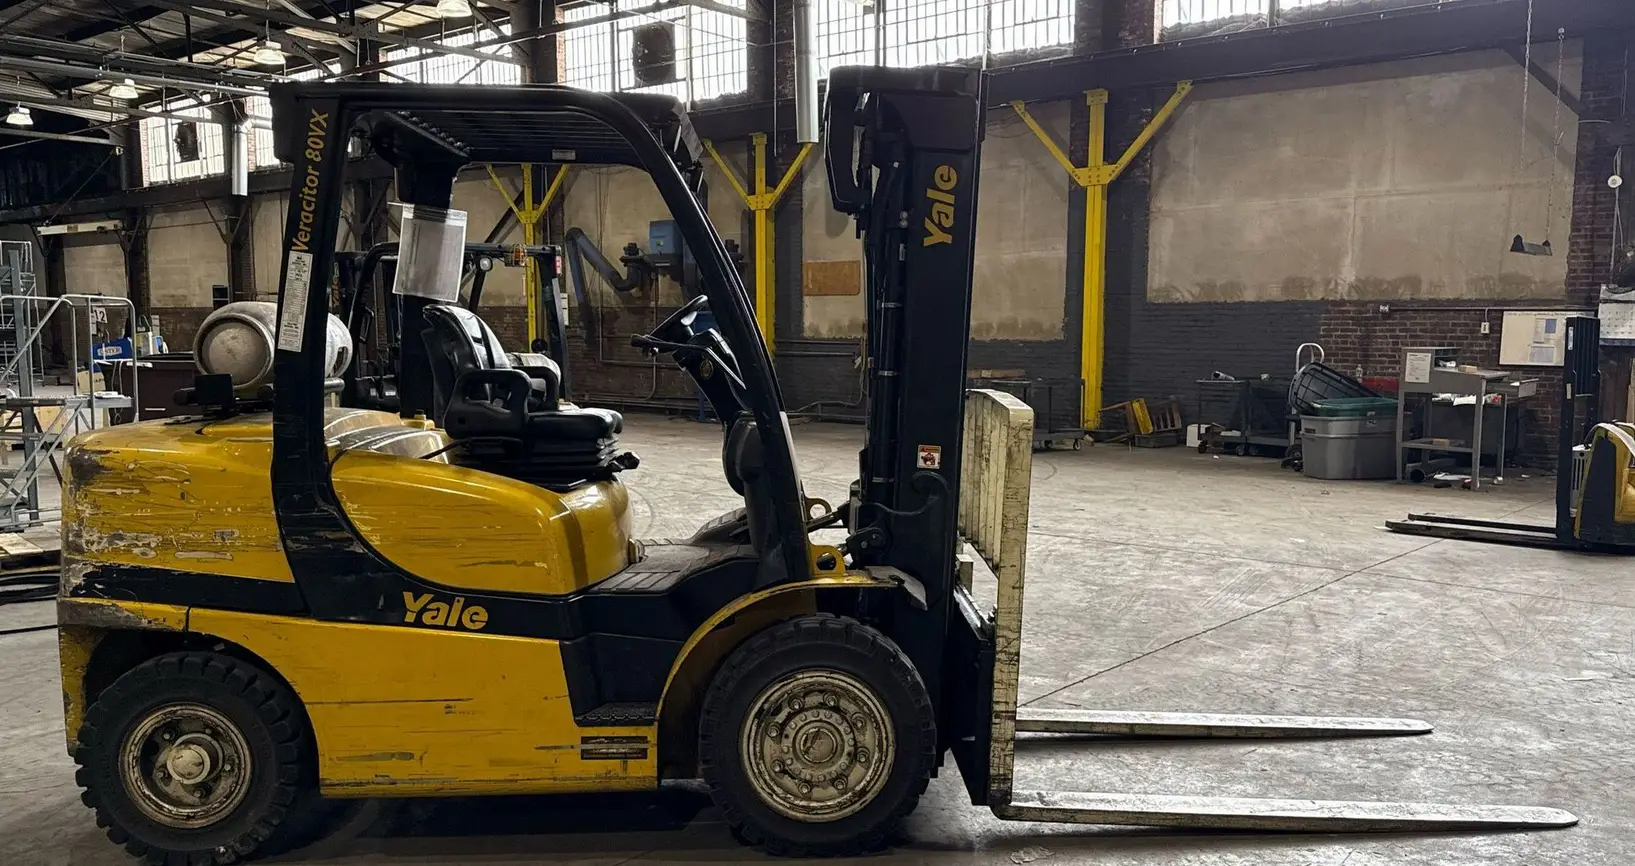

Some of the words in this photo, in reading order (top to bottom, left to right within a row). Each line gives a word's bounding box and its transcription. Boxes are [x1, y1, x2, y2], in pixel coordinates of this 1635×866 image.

[305, 108, 329, 162] 80VX
[291, 165, 320, 251] Veracitor
[924, 165, 958, 246] Yale
[94, 310, 105, 321] 12
[403, 591, 488, 630] Yale
